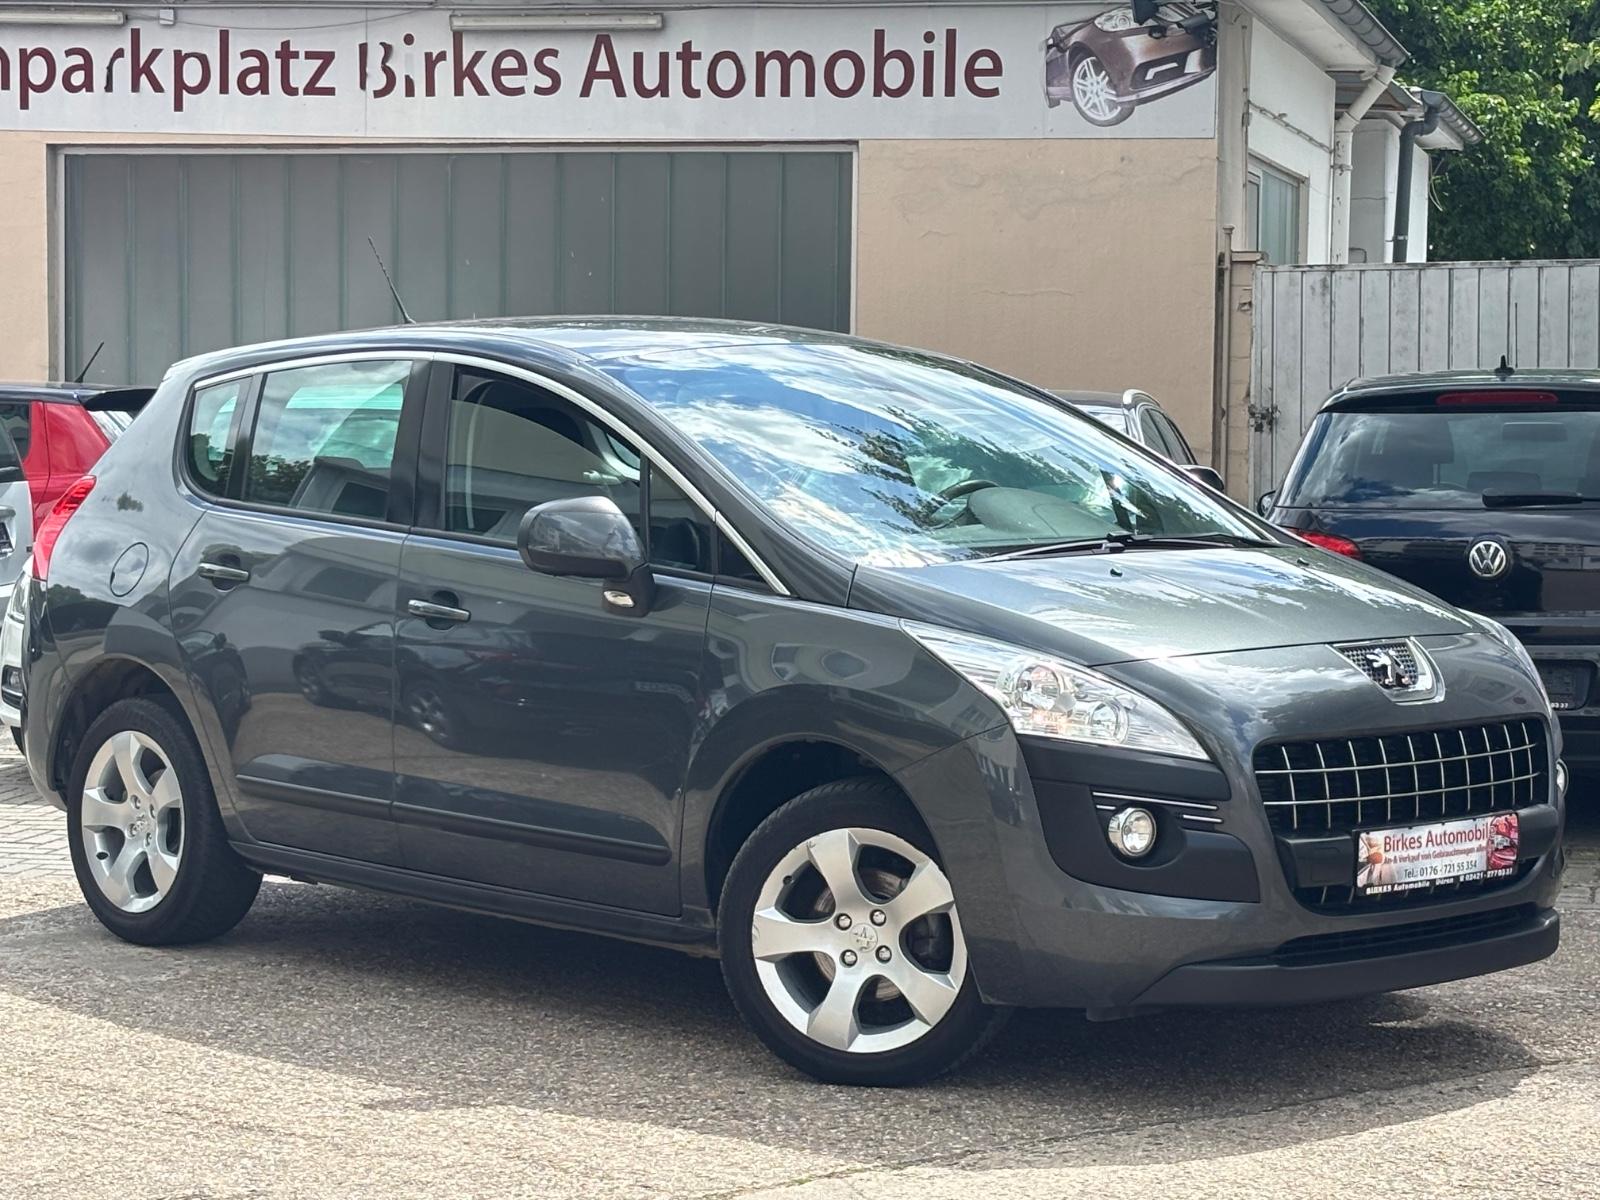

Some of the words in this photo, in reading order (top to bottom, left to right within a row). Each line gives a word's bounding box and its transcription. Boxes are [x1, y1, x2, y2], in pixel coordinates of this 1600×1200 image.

[358, 31, 562, 99] Birkes
[579, 28, 1003, 99] Automobile
[1384, 832, 1423, 853] Birkes
[1426, 822, 1497, 848] Automobile
[1420, 865, 1438, 877] 0176
[1444, 863, 1455, 874] 721
